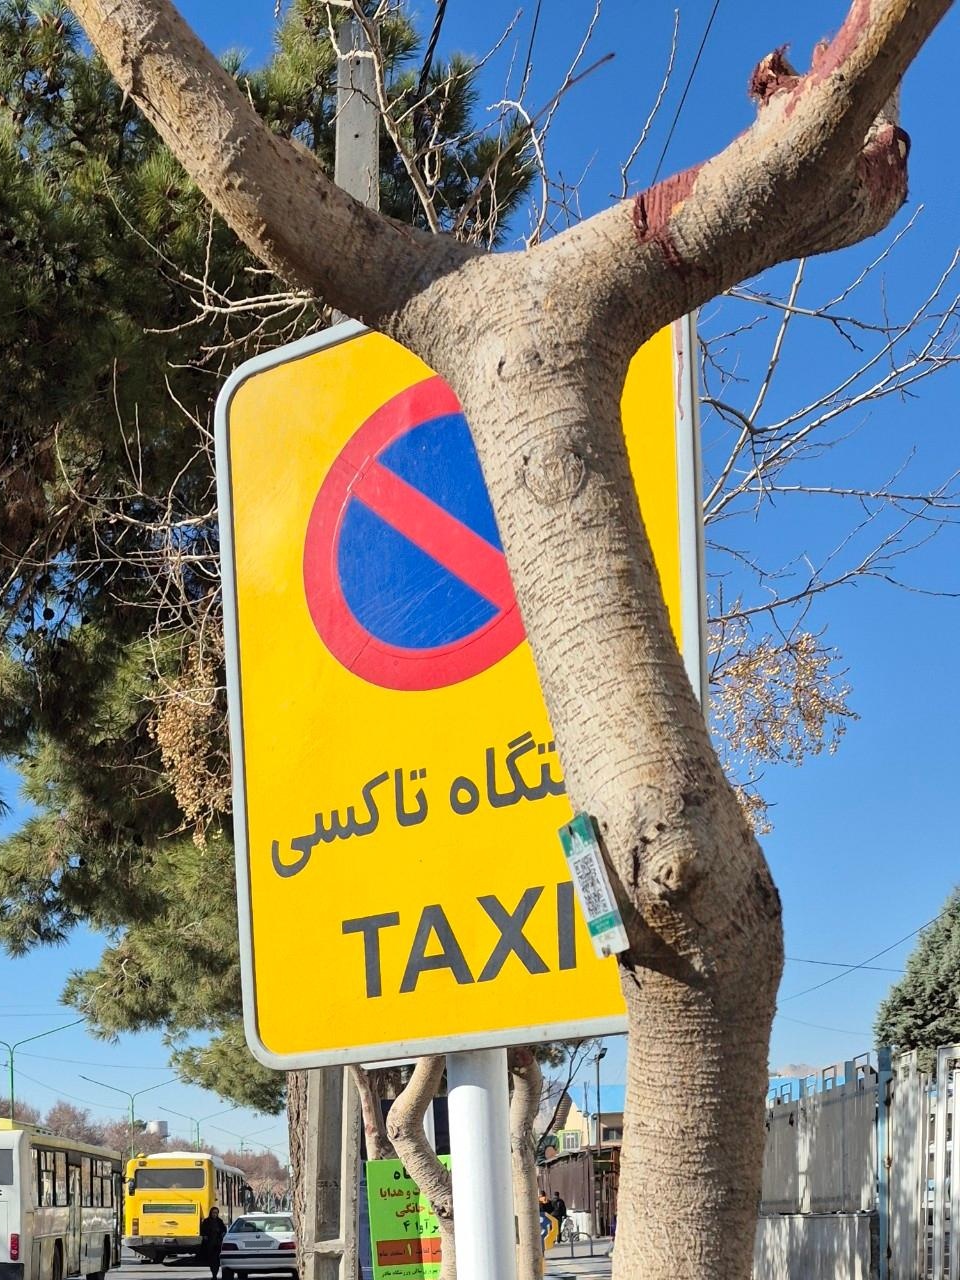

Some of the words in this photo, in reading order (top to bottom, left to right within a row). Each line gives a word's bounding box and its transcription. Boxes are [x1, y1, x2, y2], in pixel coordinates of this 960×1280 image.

[450, 732, 566, 815] تگاه
[272, 767, 428, 878] تاکسی
[343, 881, 577, 997] TAXI
[380, 1187, 404, 1200] هدایا
